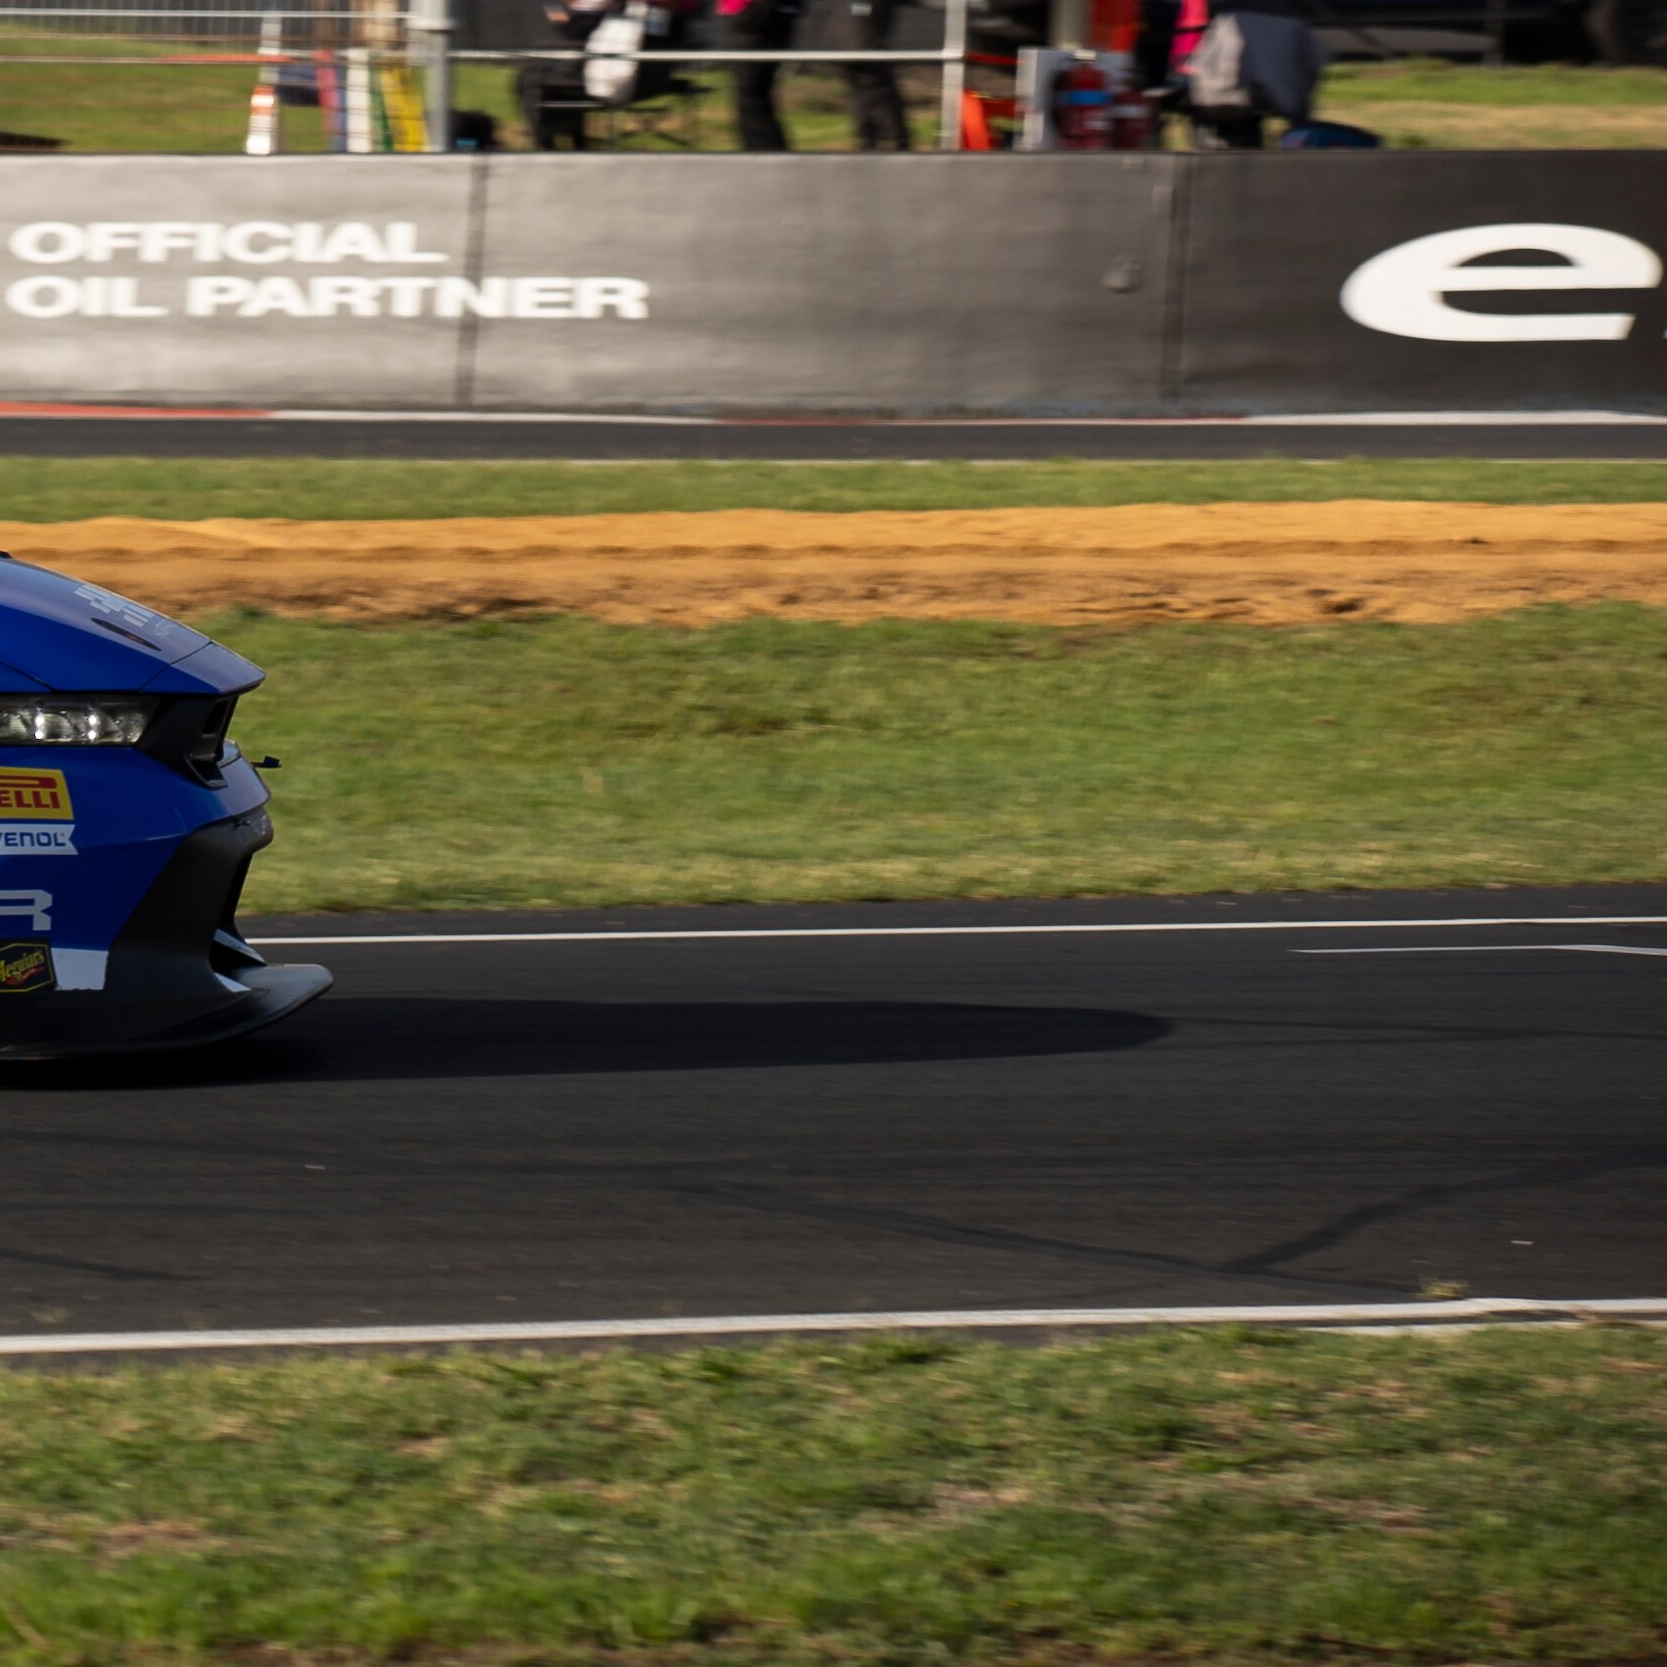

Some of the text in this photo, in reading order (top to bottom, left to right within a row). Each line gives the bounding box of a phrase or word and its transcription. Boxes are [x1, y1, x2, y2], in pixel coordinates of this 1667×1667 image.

[8, 219, 451, 265] OFFICIAL
[4, 275, 651, 320] OIL PARTNER
